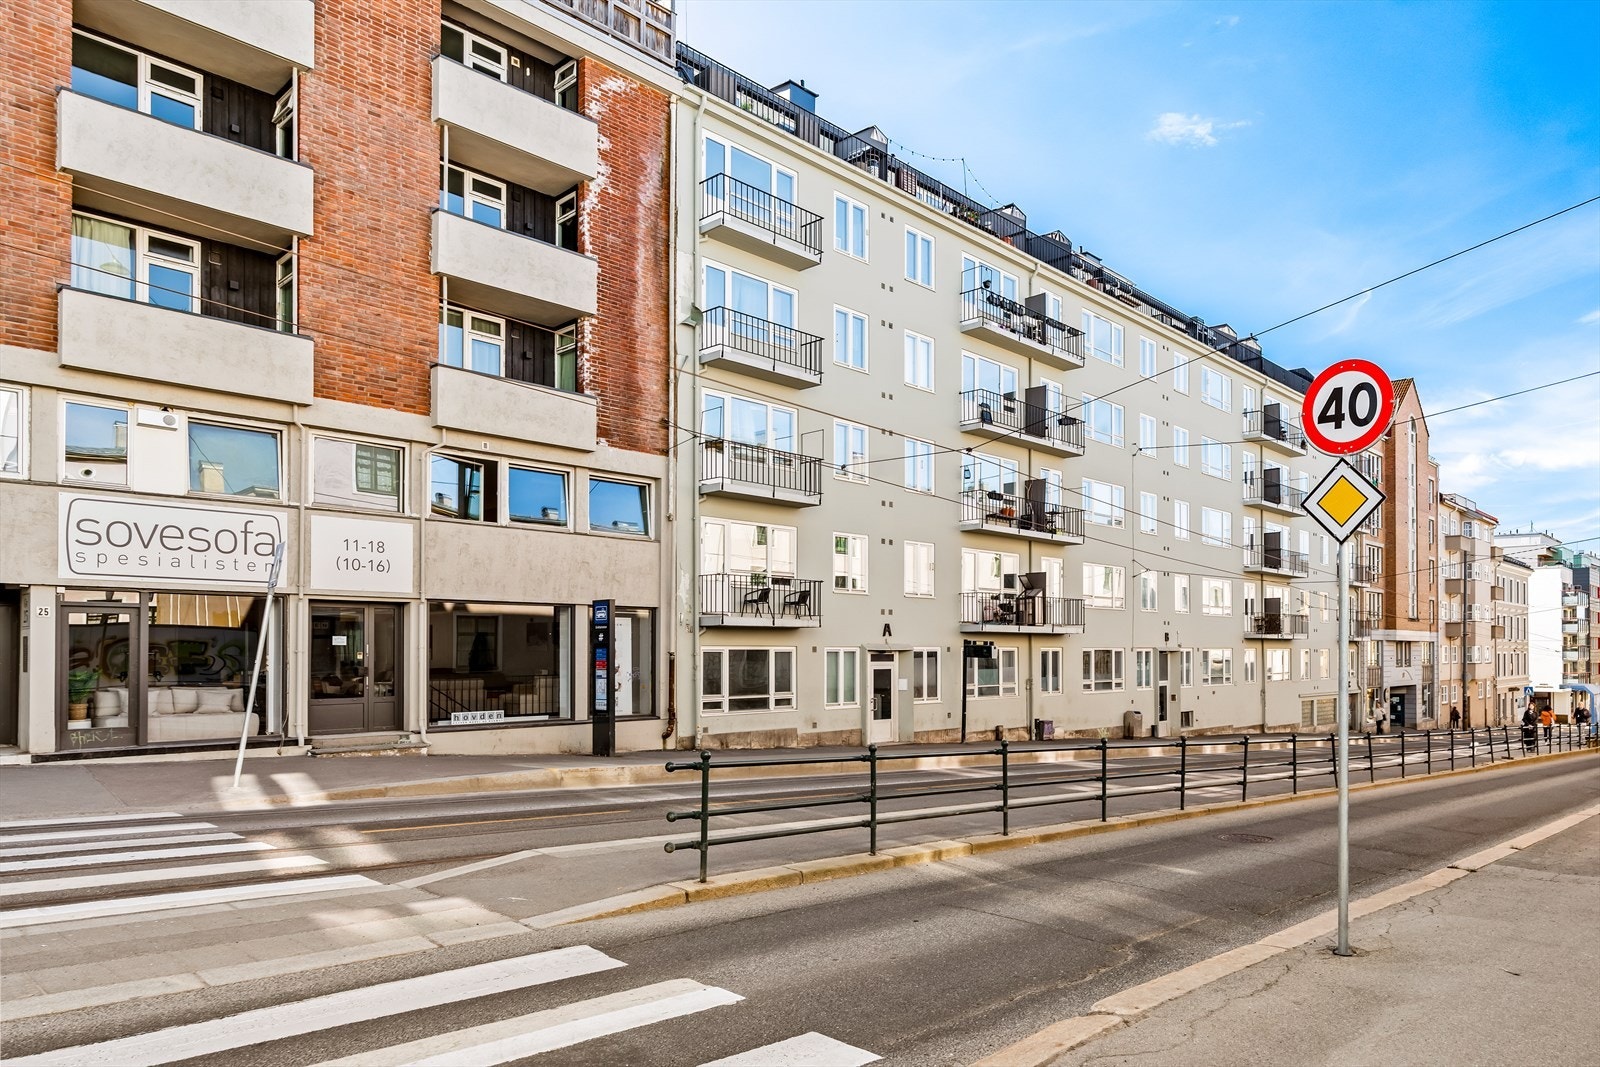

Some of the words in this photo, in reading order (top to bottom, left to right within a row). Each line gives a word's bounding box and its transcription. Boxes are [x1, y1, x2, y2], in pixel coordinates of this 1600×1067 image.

[1317, 382, 1378, 430] 40
[75, 518, 275, 557] sovesofa
[343, 538, 385, 554] 11-18
[336, 555, 391, 574] (10-16)
[38, 607, 49, 616] 25
[882, 623, 893, 637] A
[1164, 632, 1170, 642] B
[453, 712, 502, 721] hovden
